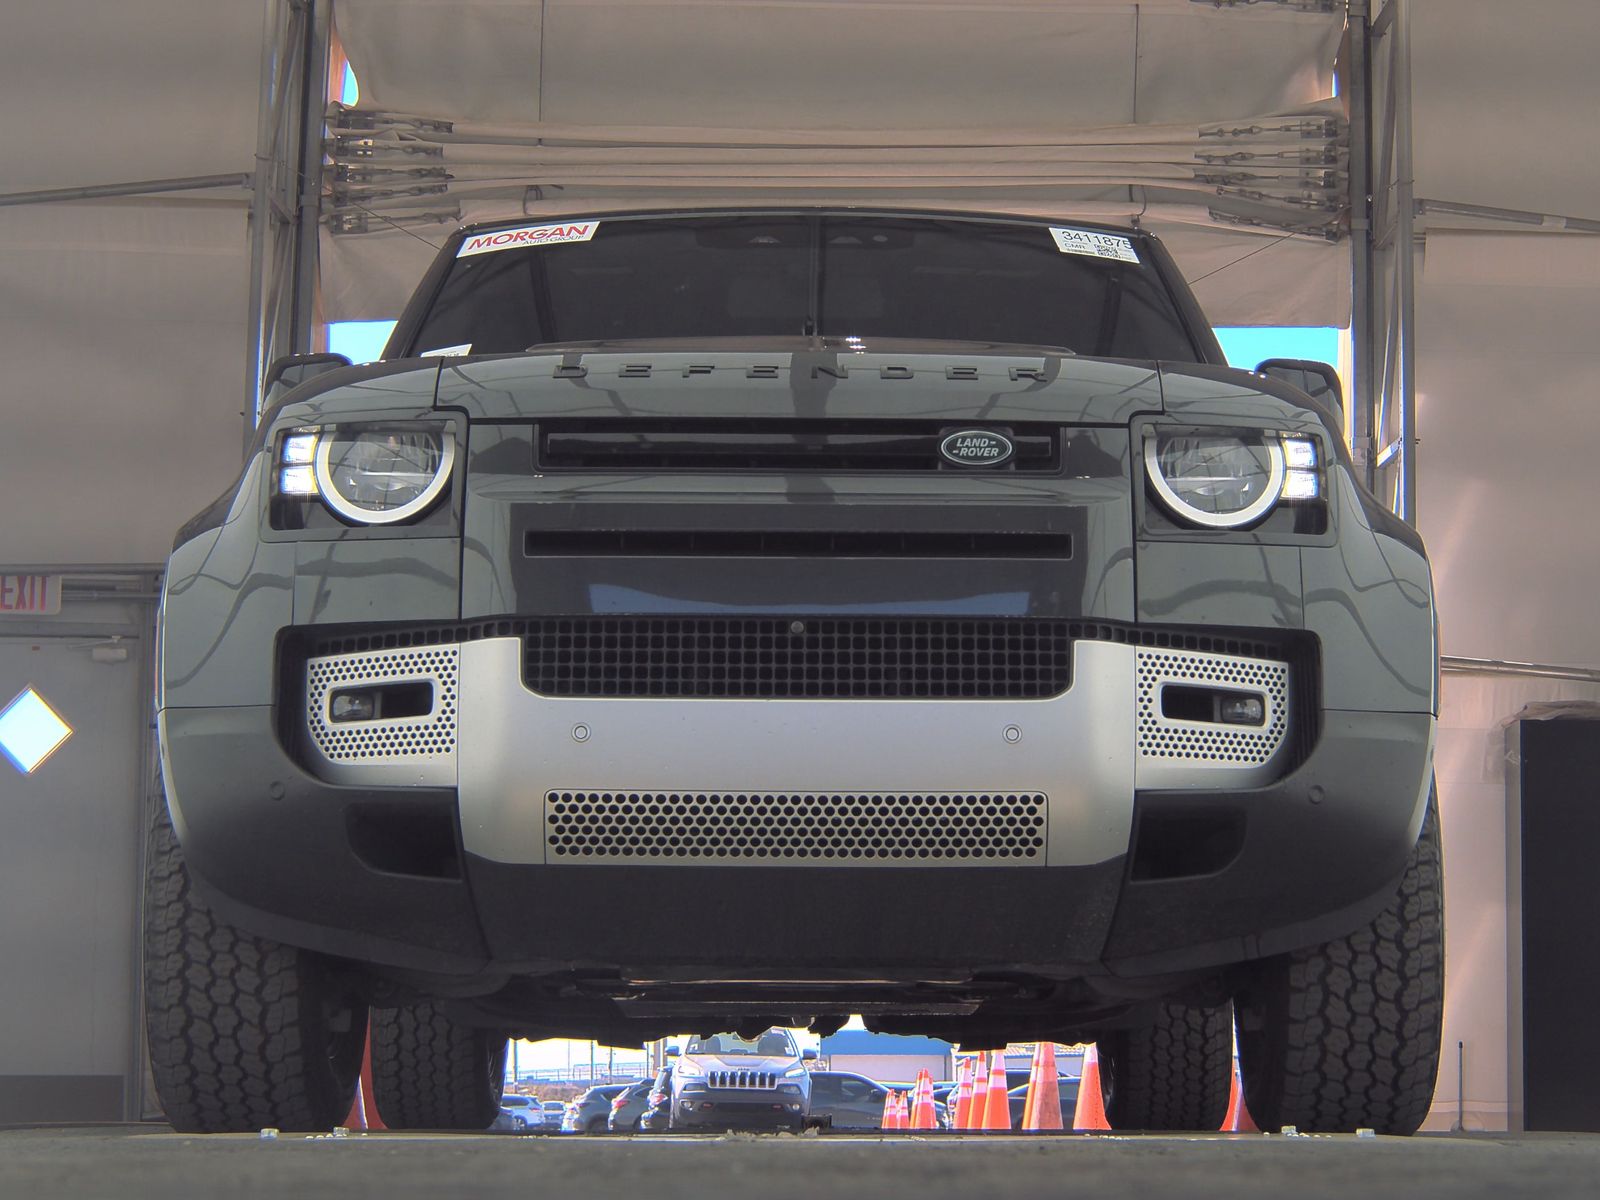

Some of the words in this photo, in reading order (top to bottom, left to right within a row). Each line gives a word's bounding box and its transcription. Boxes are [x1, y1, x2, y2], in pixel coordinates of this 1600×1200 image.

[468, 225, 589, 250] MORGAN
[521, 237, 547, 246] AUTO
[1061, 231, 1133, 250] 3411875
[552, 365, 1048, 383] DEFENDER
[0, 575, 50, 611] EXIT
